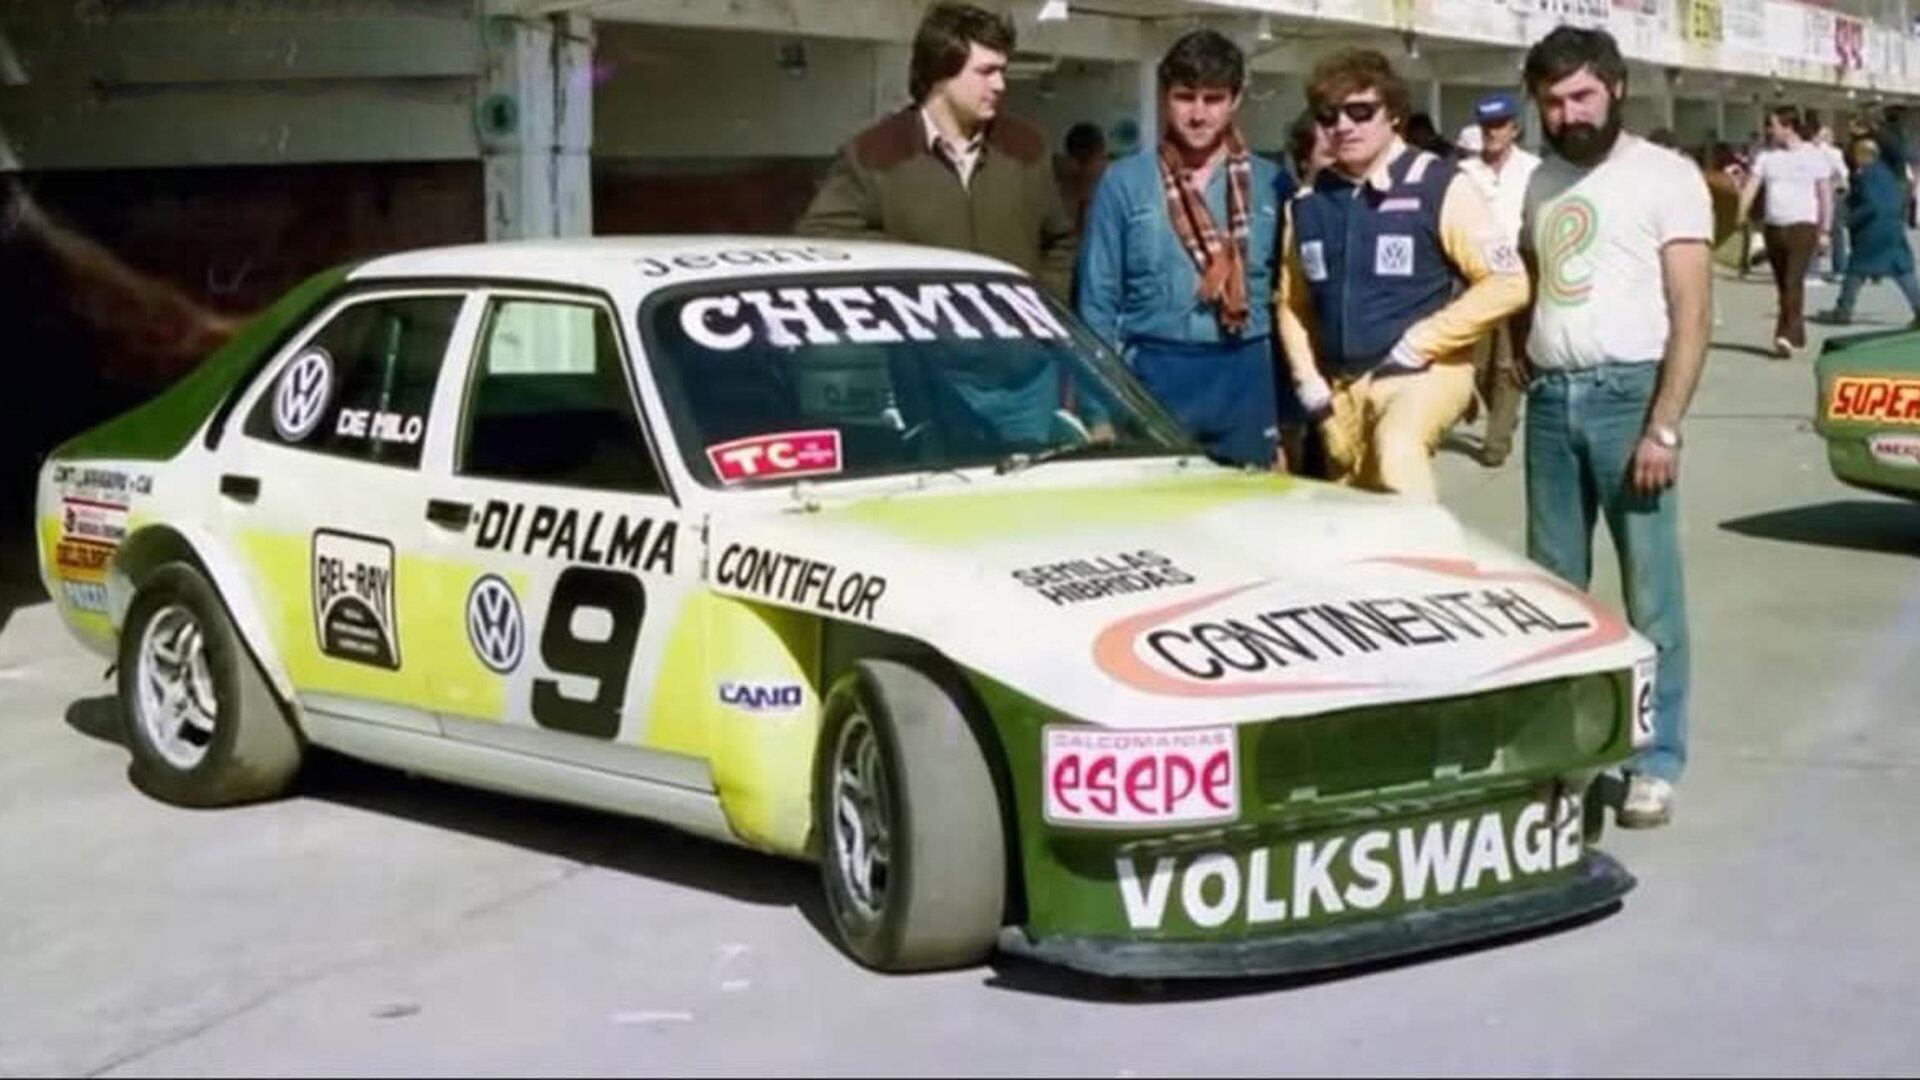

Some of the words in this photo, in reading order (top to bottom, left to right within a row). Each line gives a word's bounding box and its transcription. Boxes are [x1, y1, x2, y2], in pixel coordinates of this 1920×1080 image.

[679, 282, 1070, 350] CHEMIN
[336, 408, 370, 437] DE
[370, 411, 423, 444] MILO
[722, 442, 799, 475] TC
[475, 499, 524, 551] DI
[523, 505, 678, 575] PALMA
[1012, 550, 1172, 587] SEMILLAS
[319, 556, 390, 630] BEL-RAY
[716, 543, 886, 620] CONTIFLOR
[1038, 567, 1195, 606] HIBRIDAS
[530, 565, 647, 741] 9
[1147, 589, 1589, 680] CONTINENTAL
[1054, 750, 1231, 815] esepe
